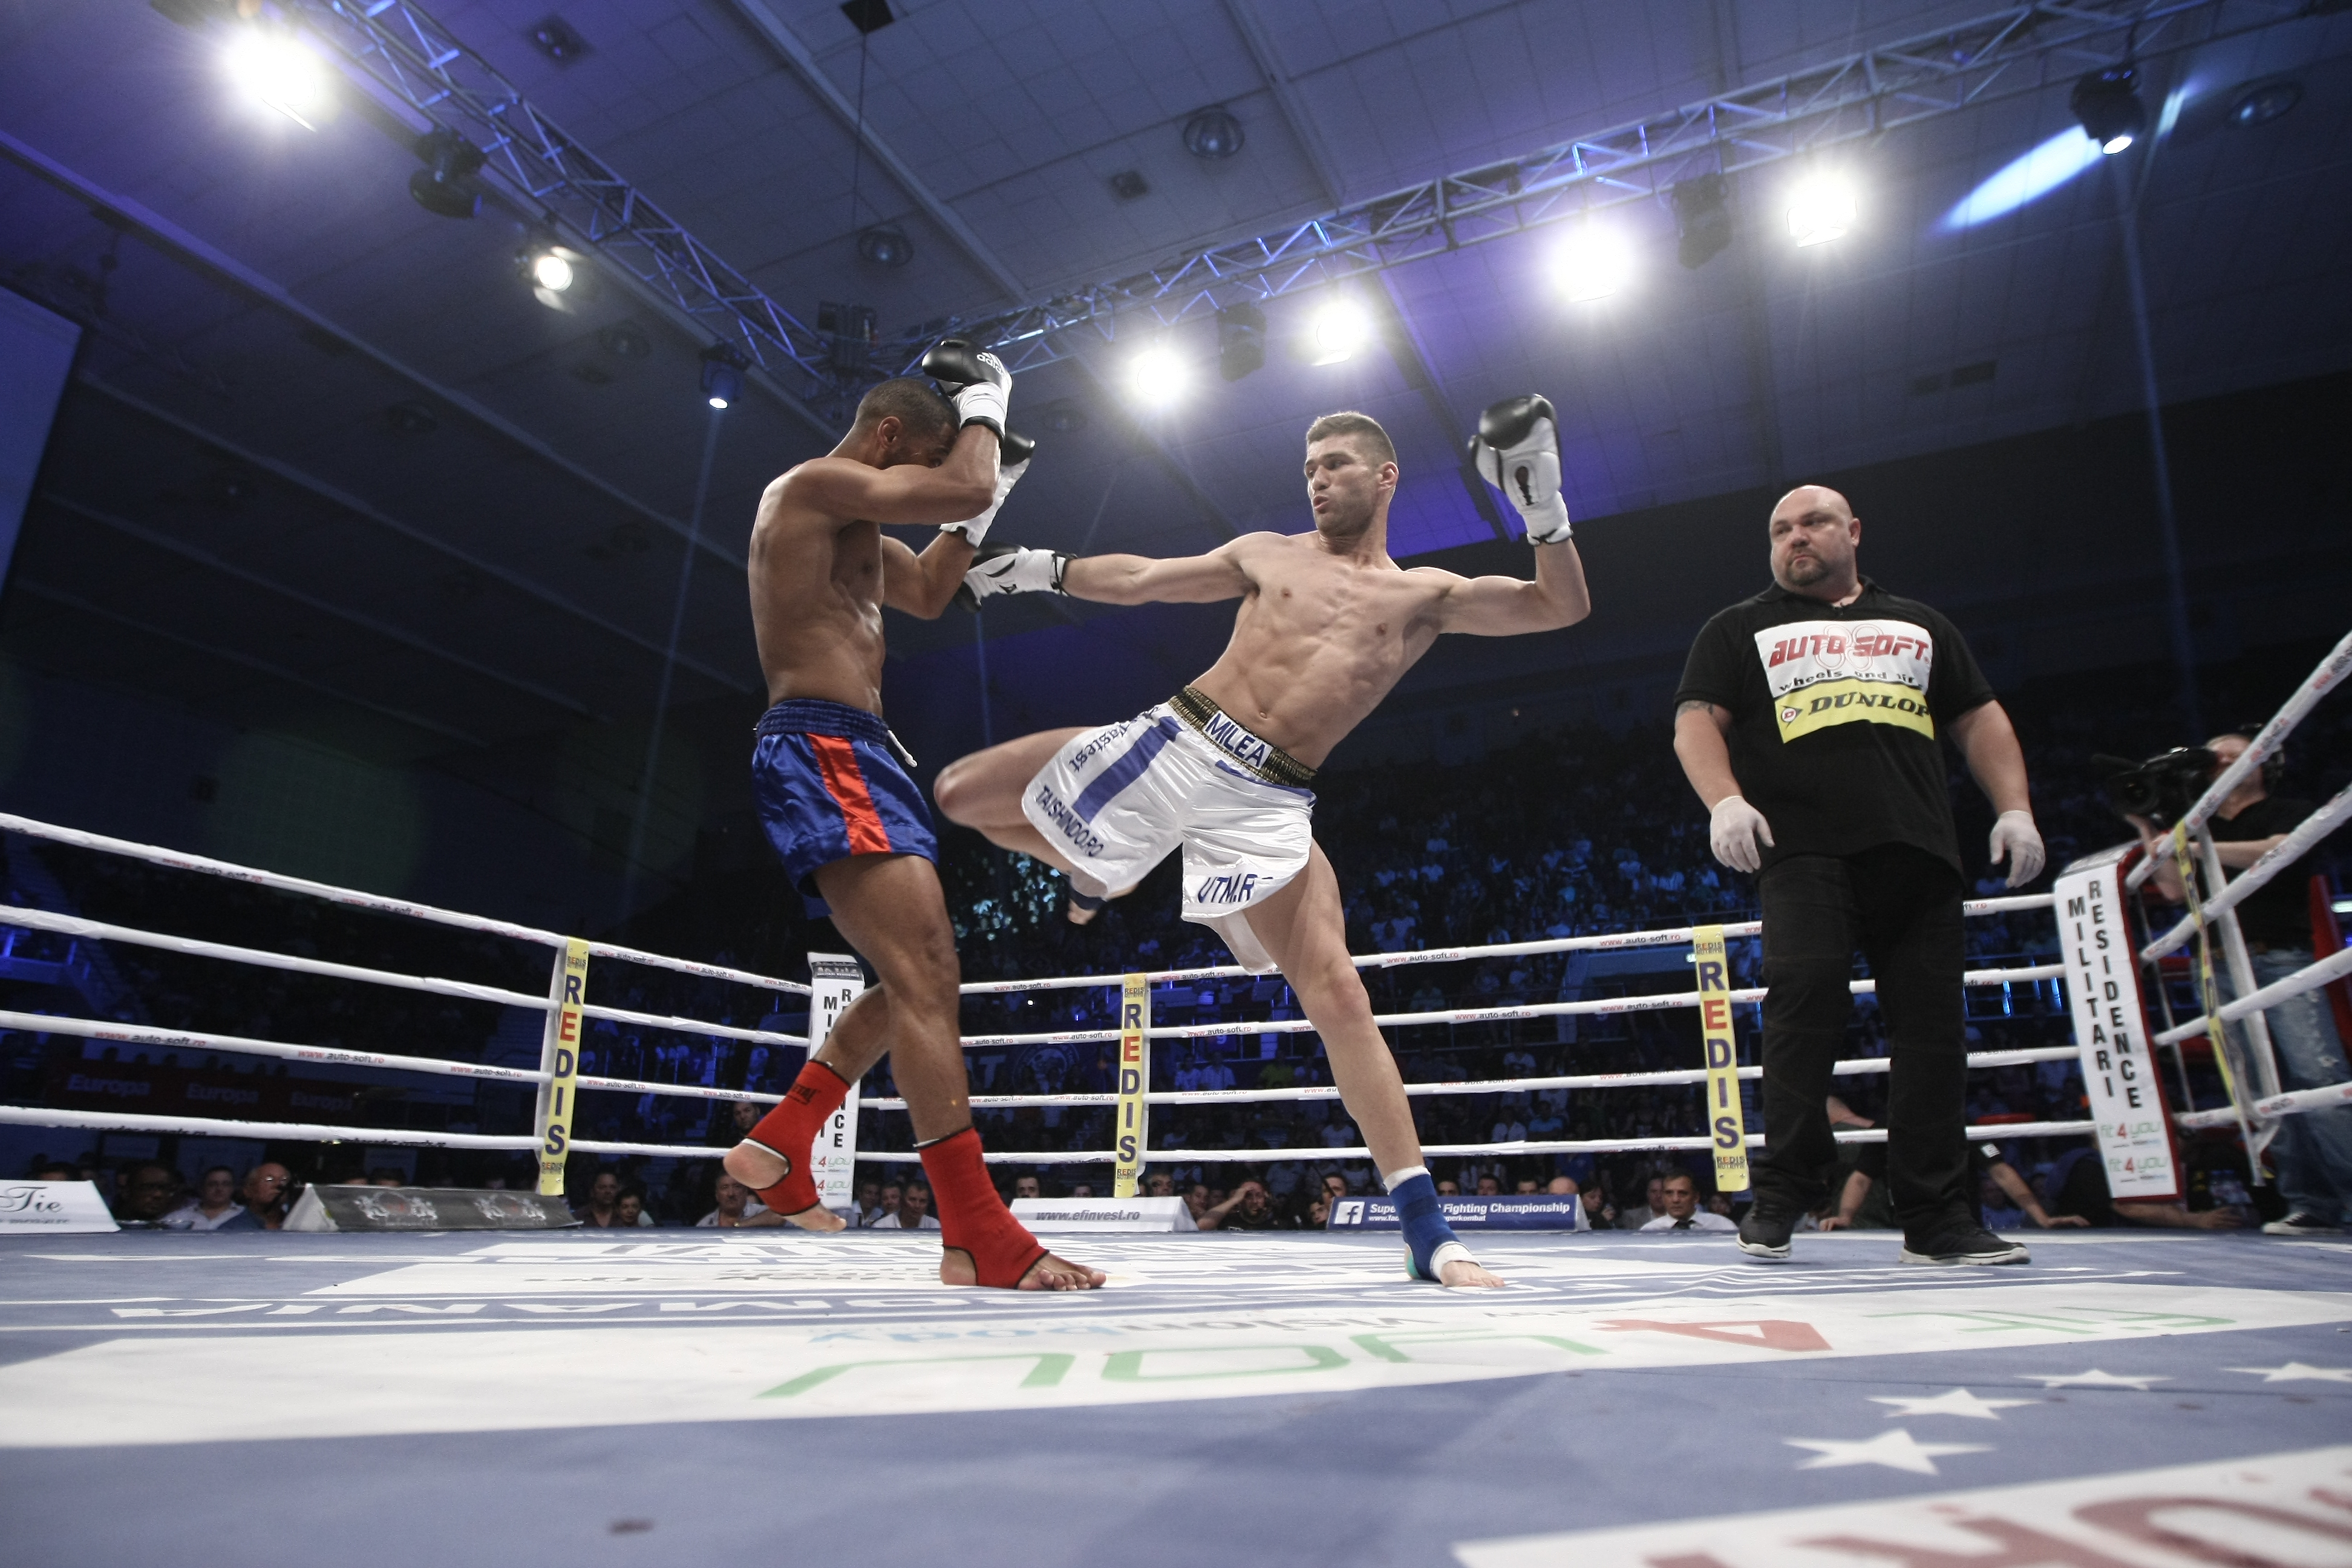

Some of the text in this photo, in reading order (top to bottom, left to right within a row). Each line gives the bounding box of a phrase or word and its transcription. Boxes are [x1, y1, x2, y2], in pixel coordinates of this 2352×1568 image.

[1780, 670, 1843, 692] wheels
[1855, 671, 1887, 679] and
[1809, 691, 1930, 717] DUNLOP
[1206, 713, 1267, 767] MILEA
[1198, 873, 1273, 903] UTM.R
[1599, 933, 1681, 946] www.auto-soft.ro
[1385, 952, 1459, 963] www.auto-soft.ro
[1161, 971, 1226, 981] www.auto-soft.ro
[994, 982, 1051, 991] www.auto-soft.ro
[2088, 880, 2141, 1109] RESIDENCE
[2068, 896, 2114, 1099] MILITARI
[1601, 1000, 1683, 1012] www.auto-soft.ro
[1455, 1010, 1531, 1020] www.auto-soft.ro
[95, 1031, 206, 1048] www.auto-soft.ro
[1052, 1031, 1112, 1040] www.auto-soft.ro
[1186, 1026, 1252, 1037] www.auto-soft.ro
[1699, 961, 1739, 1149] REDIS
[545, 975, 582, 1155] REDIS
[1119, 1004, 1142, 1163] REDIS
[2117, 1123, 2127, 1139] 4
[1716, 1156, 1745, 1165] REDIS
[2124, 1157, 2134, 1173] 4
[3, 1186, 64, 1213] Tie
[1035, 1208, 1141, 1223] www.efinvest.ro
[1444, 1203, 1488, 1215] Fighting
[1491, 1202, 1570, 1215] Championship
[1592, 1318, 1834, 1351] 4
